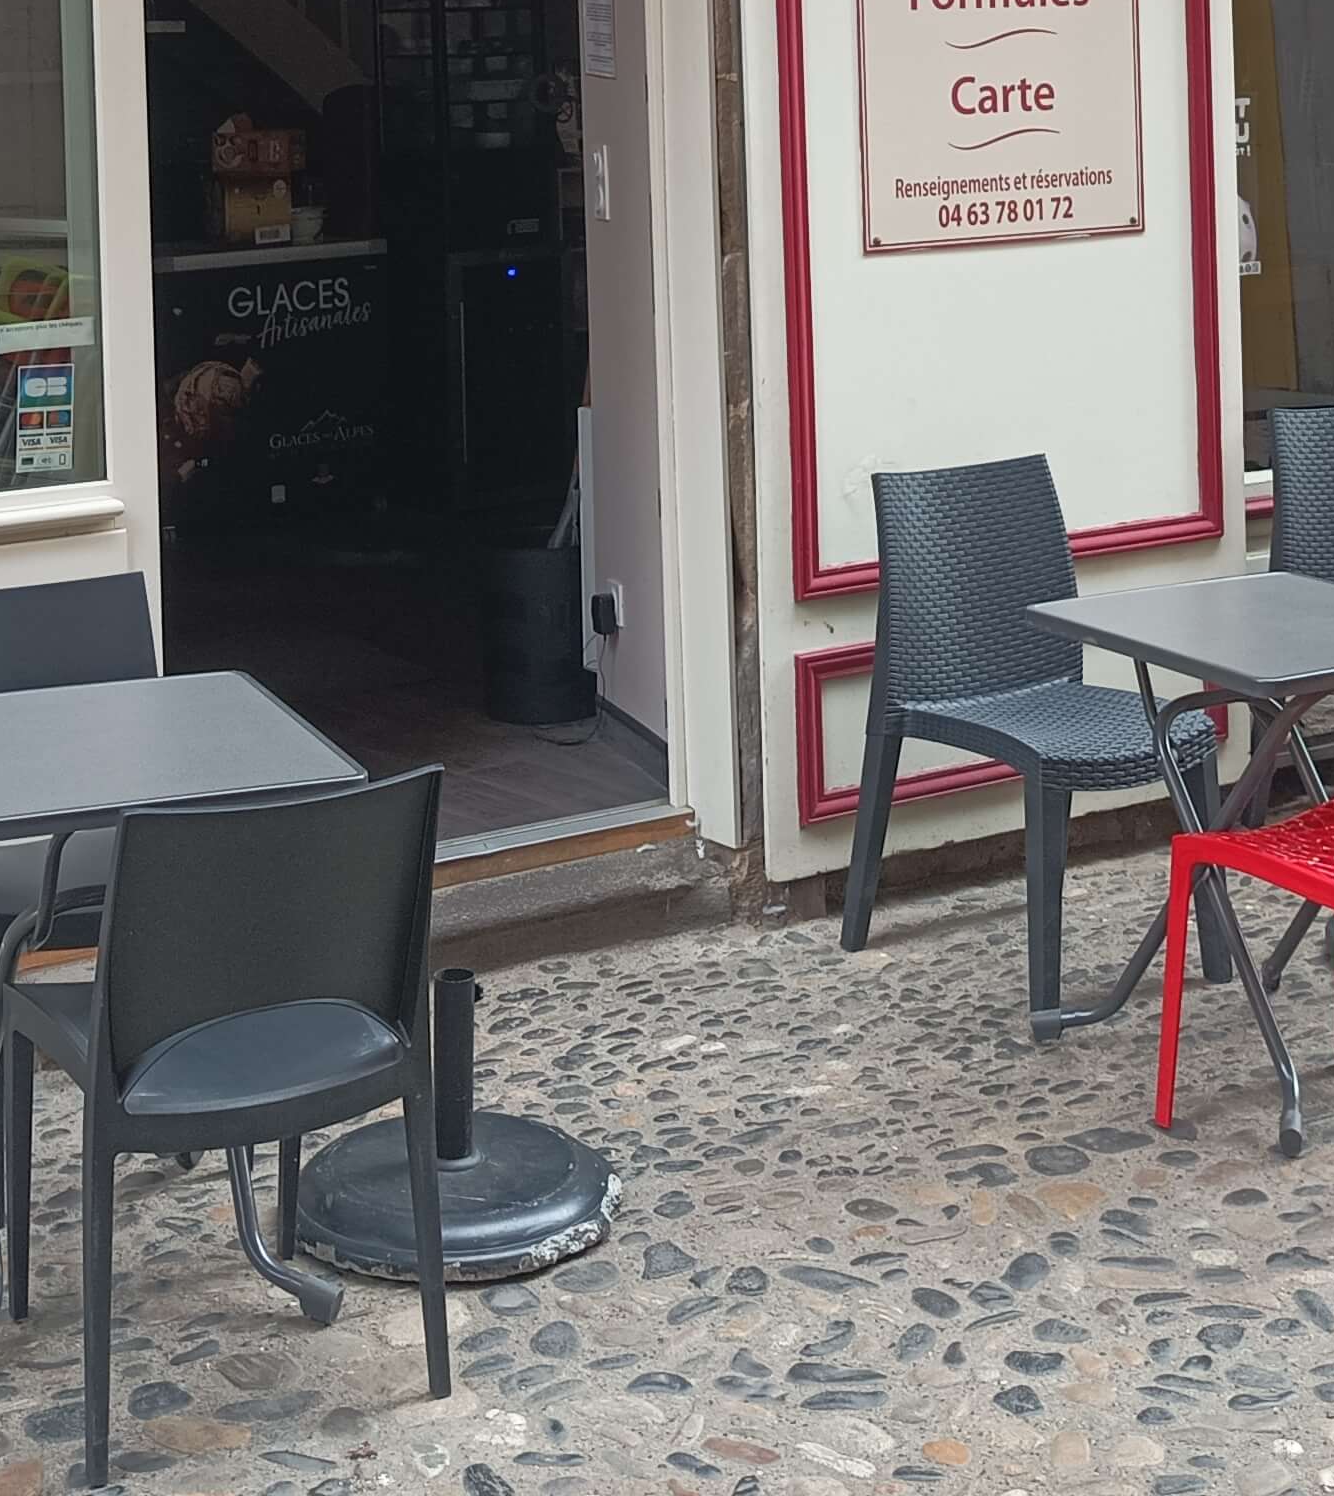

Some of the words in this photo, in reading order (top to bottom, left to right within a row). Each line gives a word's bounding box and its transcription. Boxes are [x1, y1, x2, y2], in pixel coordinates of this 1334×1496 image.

[951, 76, 1055, 115] Carte
[895, 173, 1010, 200] Renseignements
[1014, 175, 1027, 191] et
[1031, 166, 1112, 191] réservations
[939, 203, 962, 228] 04
[967, 201, 990, 226] 63
[995, 199, 1018, 224] 78
[1023, 197, 1045, 222] 01
[1050, 195, 1074, 220] 72
[228, 277, 350, 318] GLACES
[257, 301, 372, 349] Artisanales
[21, 438, 41, 446] VISA
[49, 436, 68, 444] VISA
